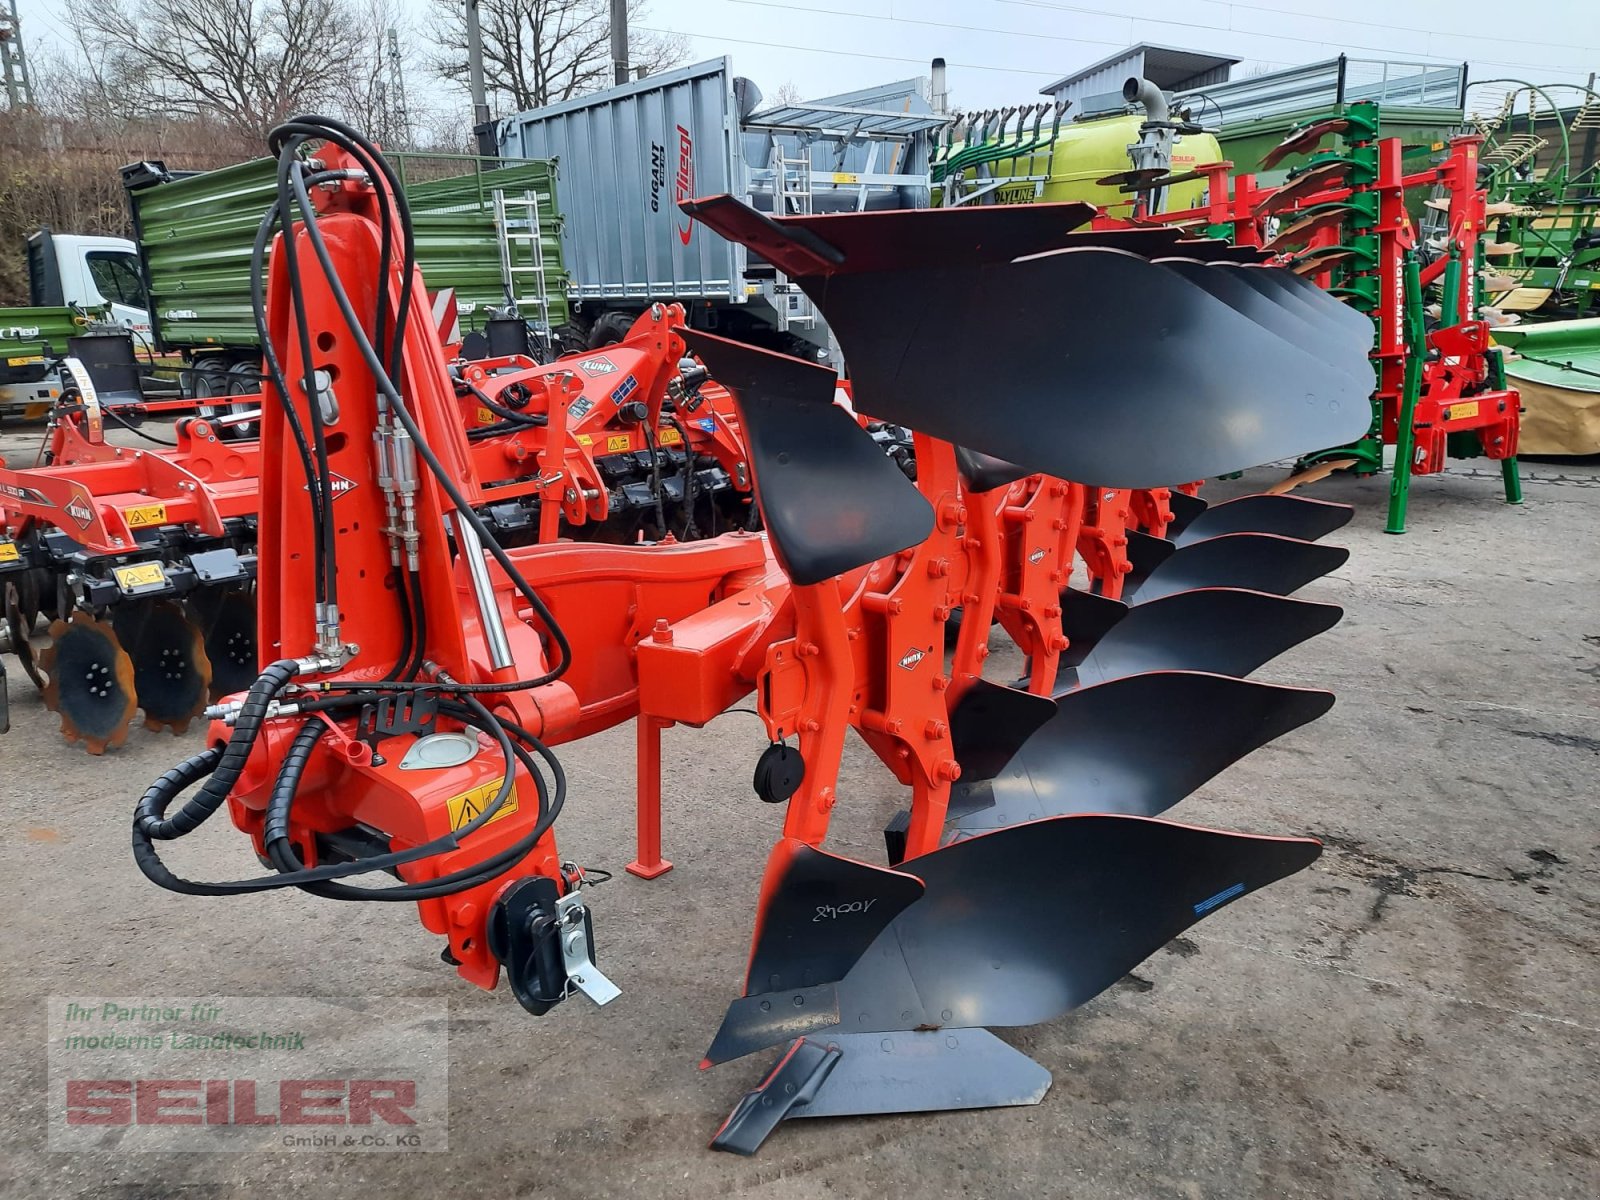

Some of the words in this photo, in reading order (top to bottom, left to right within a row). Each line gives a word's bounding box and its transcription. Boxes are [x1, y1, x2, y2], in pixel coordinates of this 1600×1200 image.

[676, 124, 692, 202] Fliegl
[651, 140, 660, 213] GIGANT
[994, 189, 1034, 202] OLYLINE
[457, 301, 476, 315] iegl
[583, 361, 613, 373] KUHN
[86, 392, 93, 400] 5
[92, 420, 99, 429] 1
[18, 488, 25, 497] R
[70, 505, 93, 520] KUHN
[902, 652, 921, 666] KUHN
[812, 899, 877, 922] 10048
